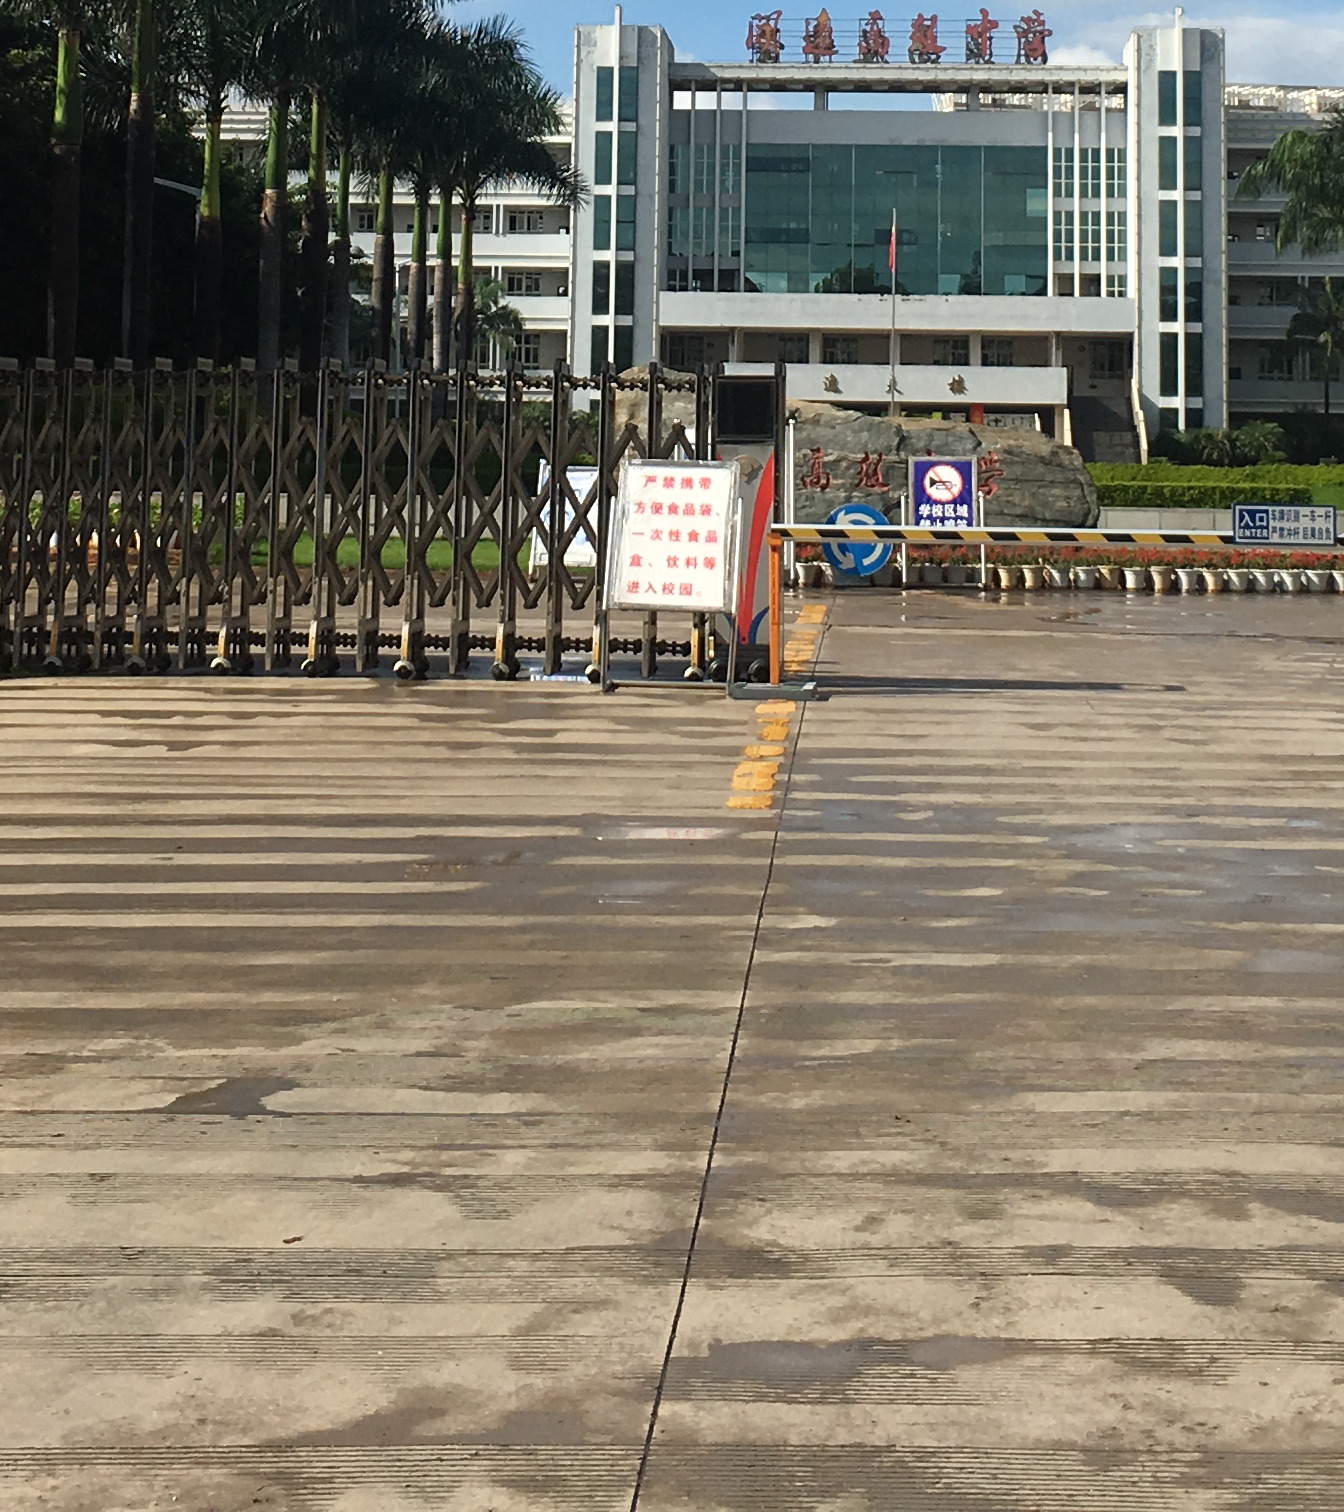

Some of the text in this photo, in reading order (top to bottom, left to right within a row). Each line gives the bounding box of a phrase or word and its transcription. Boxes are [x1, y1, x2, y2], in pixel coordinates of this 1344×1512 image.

[642, 474, 713, 490] 严禁携带
[918, 503, 969, 518] 学校区域
[1240, 511, 1268, 527] 入口
[631, 527, 718, 543] 一次性食品
[1238, 528, 1269, 538] ENTER
